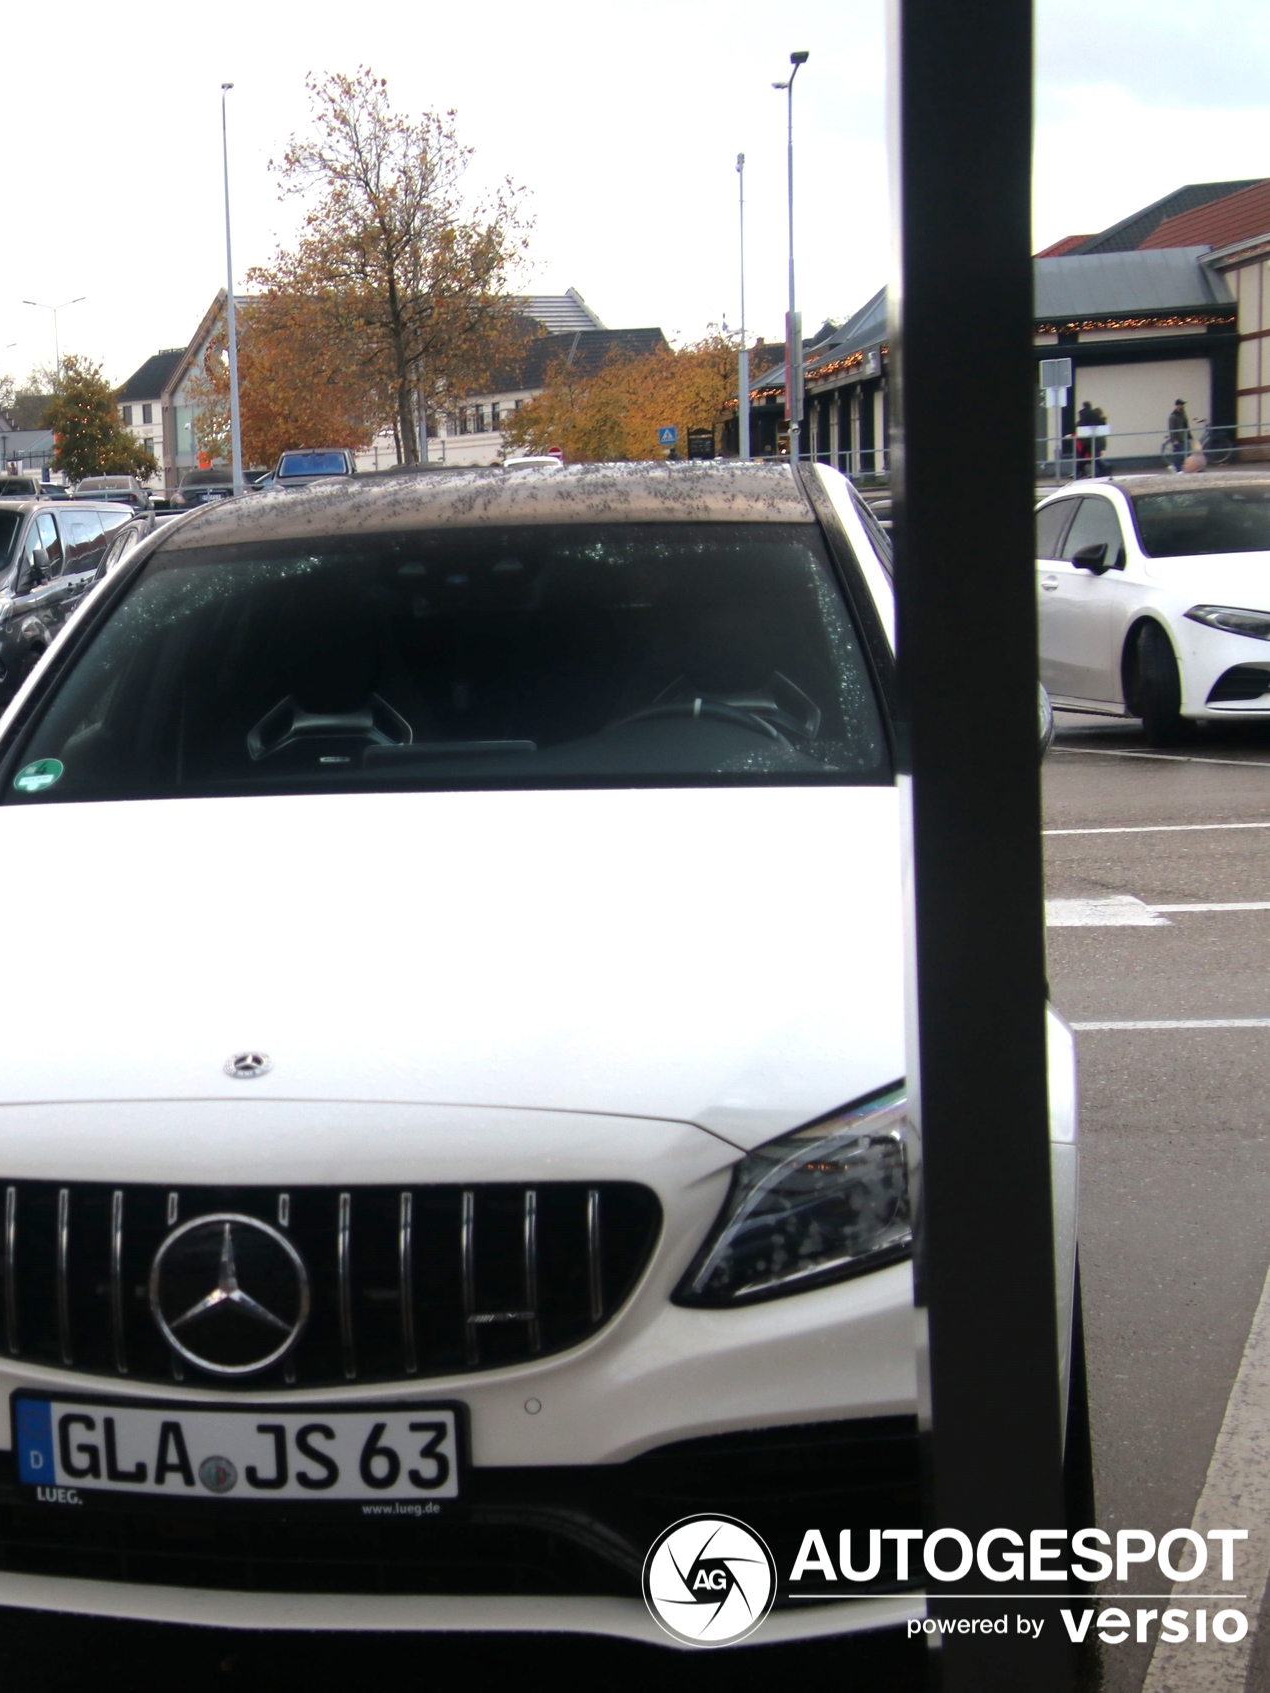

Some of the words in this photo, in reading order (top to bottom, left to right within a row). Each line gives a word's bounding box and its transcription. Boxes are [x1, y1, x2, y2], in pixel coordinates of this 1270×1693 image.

[34, 761, 48, 775] 4
[30, 1450, 43, 1469] D
[58, 1413, 196, 1487] GLA
[245, 1423, 339, 1490] JS
[359, 1421, 450, 1490] 63
[37, 1486, 83, 1505] LUEG.
[362, 1502, 440, 1516] www.lueg.de
